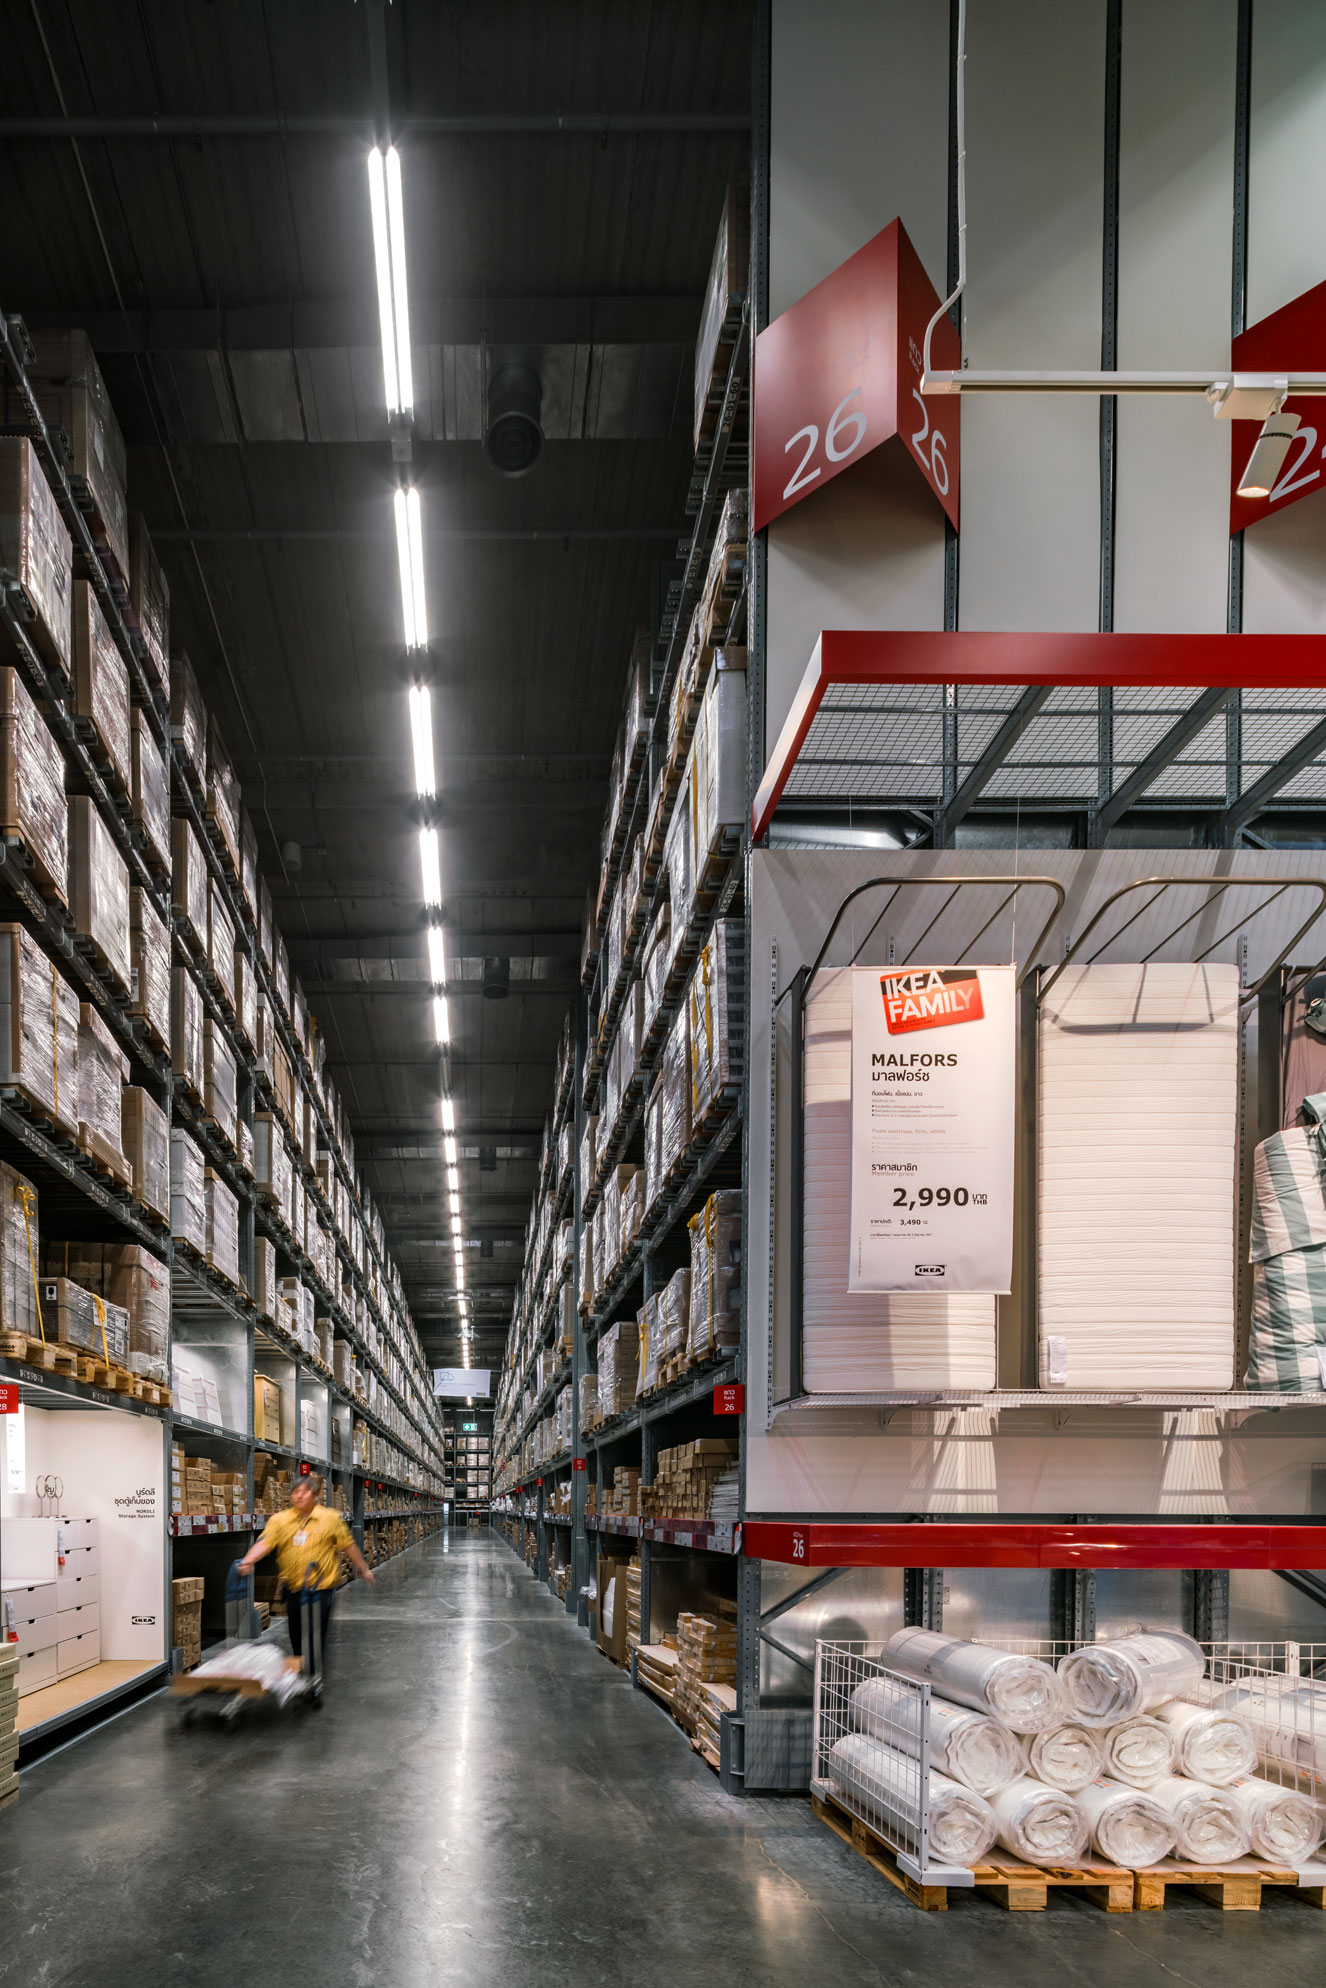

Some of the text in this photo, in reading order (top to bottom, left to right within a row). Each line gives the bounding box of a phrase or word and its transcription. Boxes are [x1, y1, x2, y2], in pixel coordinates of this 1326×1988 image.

[782, 387, 867, 500] 26
[911, 388, 949, 496] 26
[1269, 427, 1326, 503] 2
[884, 970, 946, 1000] IKEA
[888, 987, 975, 1023] FAMILY
[872, 1053, 957, 1067] MALFORS
[871, 1162, 918, 1171] ราคาสมาชิก
[893, 1187, 969, 1211] 2,990
[724, 1403, 735, 1411] 26
[793, 1539, 804, 1559] 26
